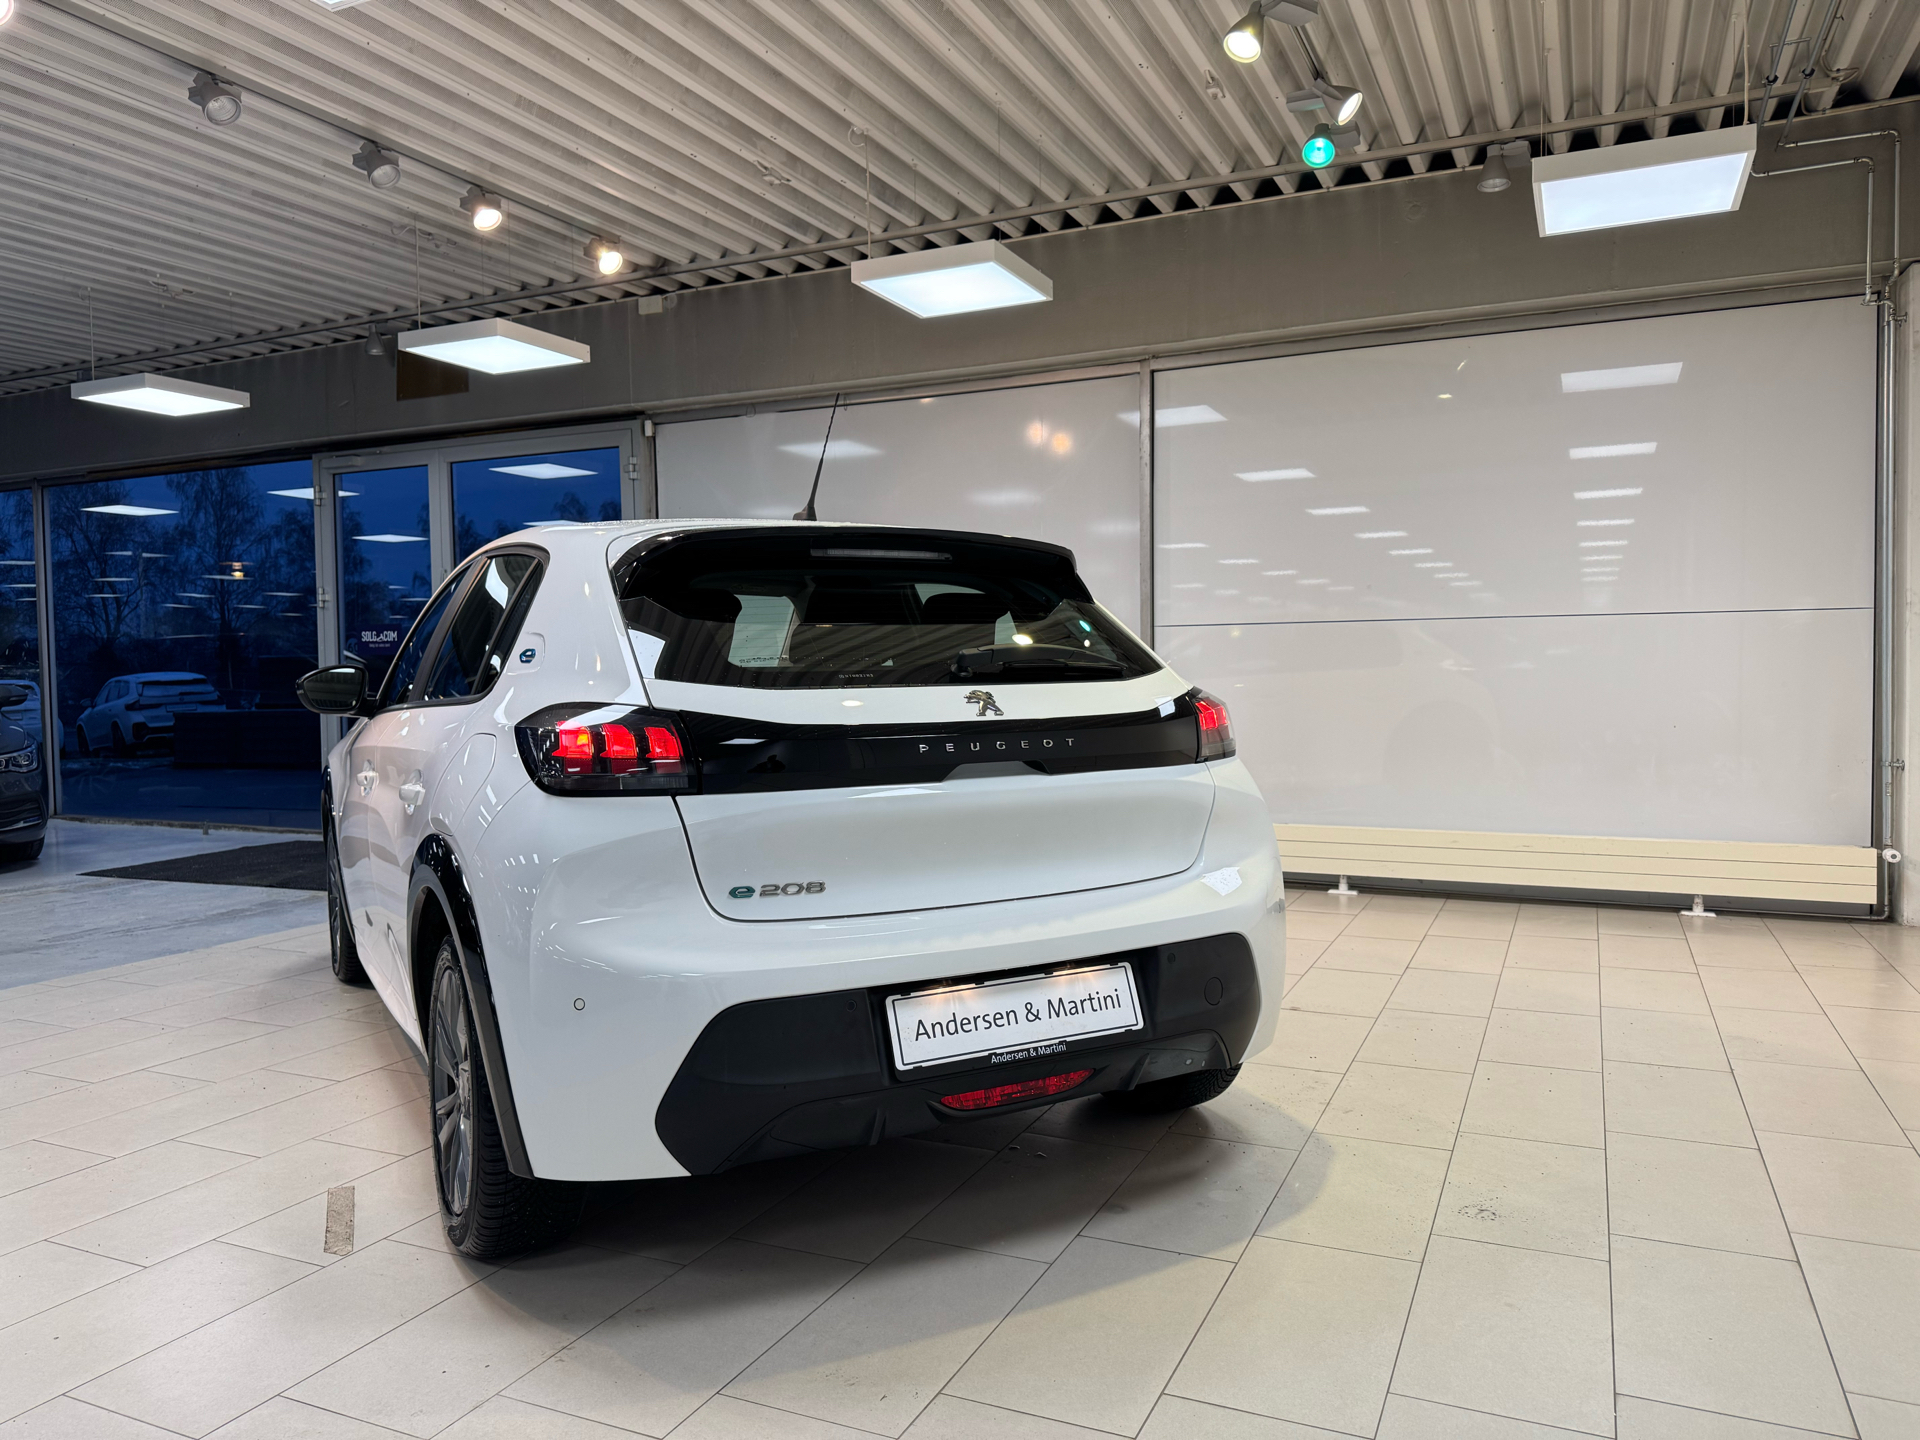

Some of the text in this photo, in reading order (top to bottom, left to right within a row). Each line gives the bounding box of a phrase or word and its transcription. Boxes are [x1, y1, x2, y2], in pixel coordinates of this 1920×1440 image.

[919, 738, 1075, 753] PEUGEOT
[759, 880, 826, 897] 208
[915, 988, 1122, 1041] Andersen & Martini
[990, 1042, 1067, 1064] Andersen & Martini
